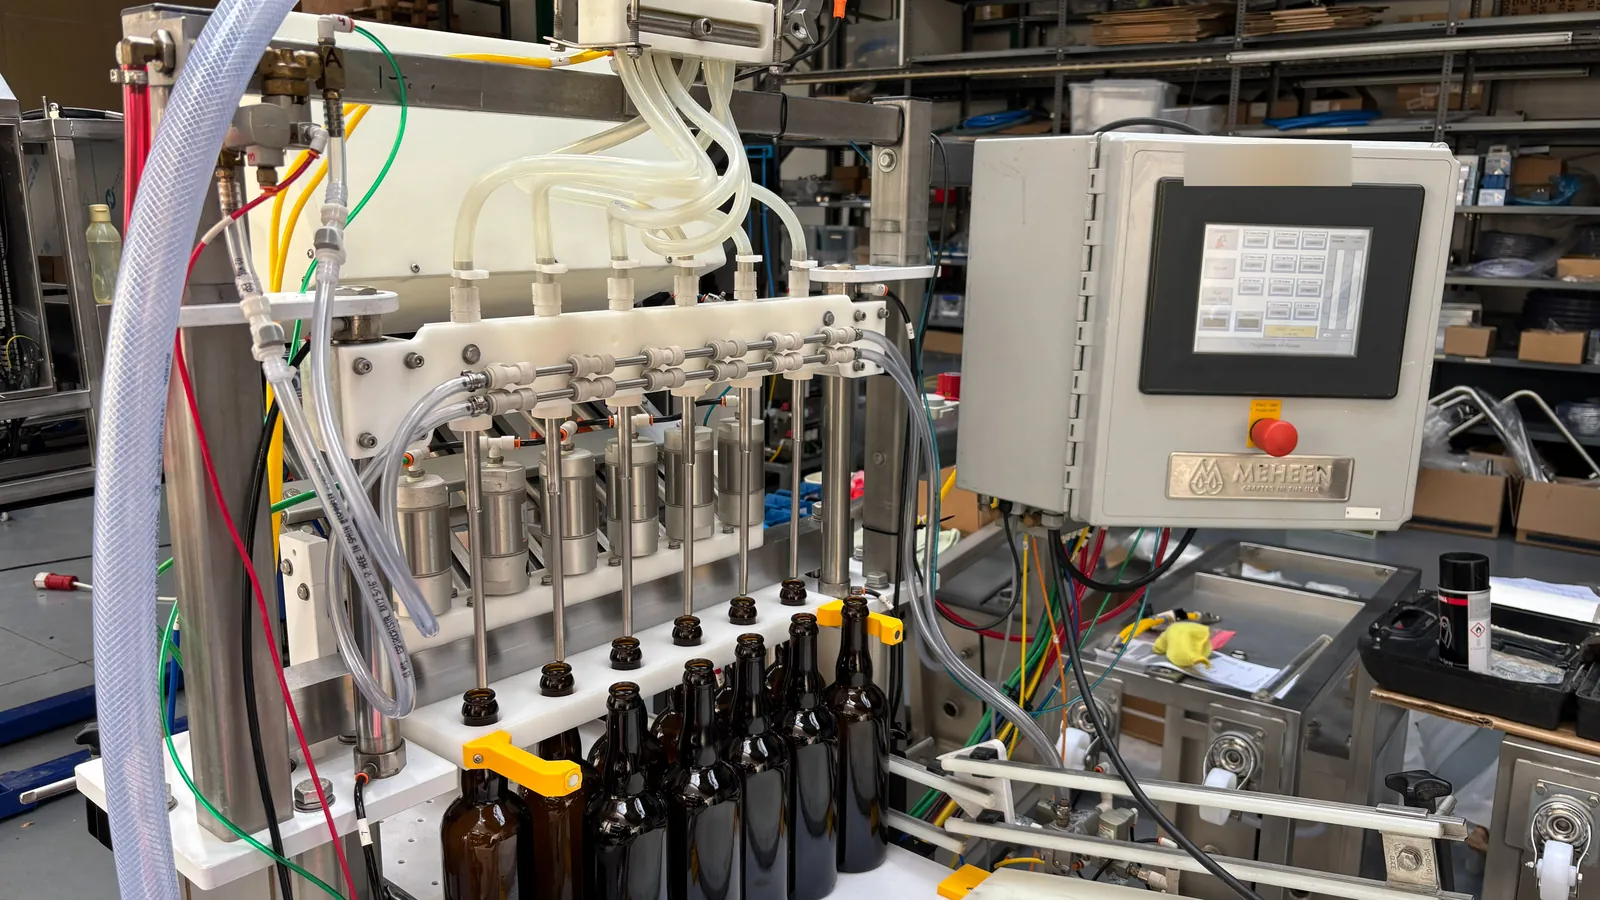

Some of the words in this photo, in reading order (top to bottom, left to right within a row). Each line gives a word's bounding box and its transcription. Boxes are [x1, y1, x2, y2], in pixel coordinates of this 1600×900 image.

[326, 46, 342, 68] A
[1232, 463, 1332, 484] MEHEEN
[351, 543, 361, 553] IN
